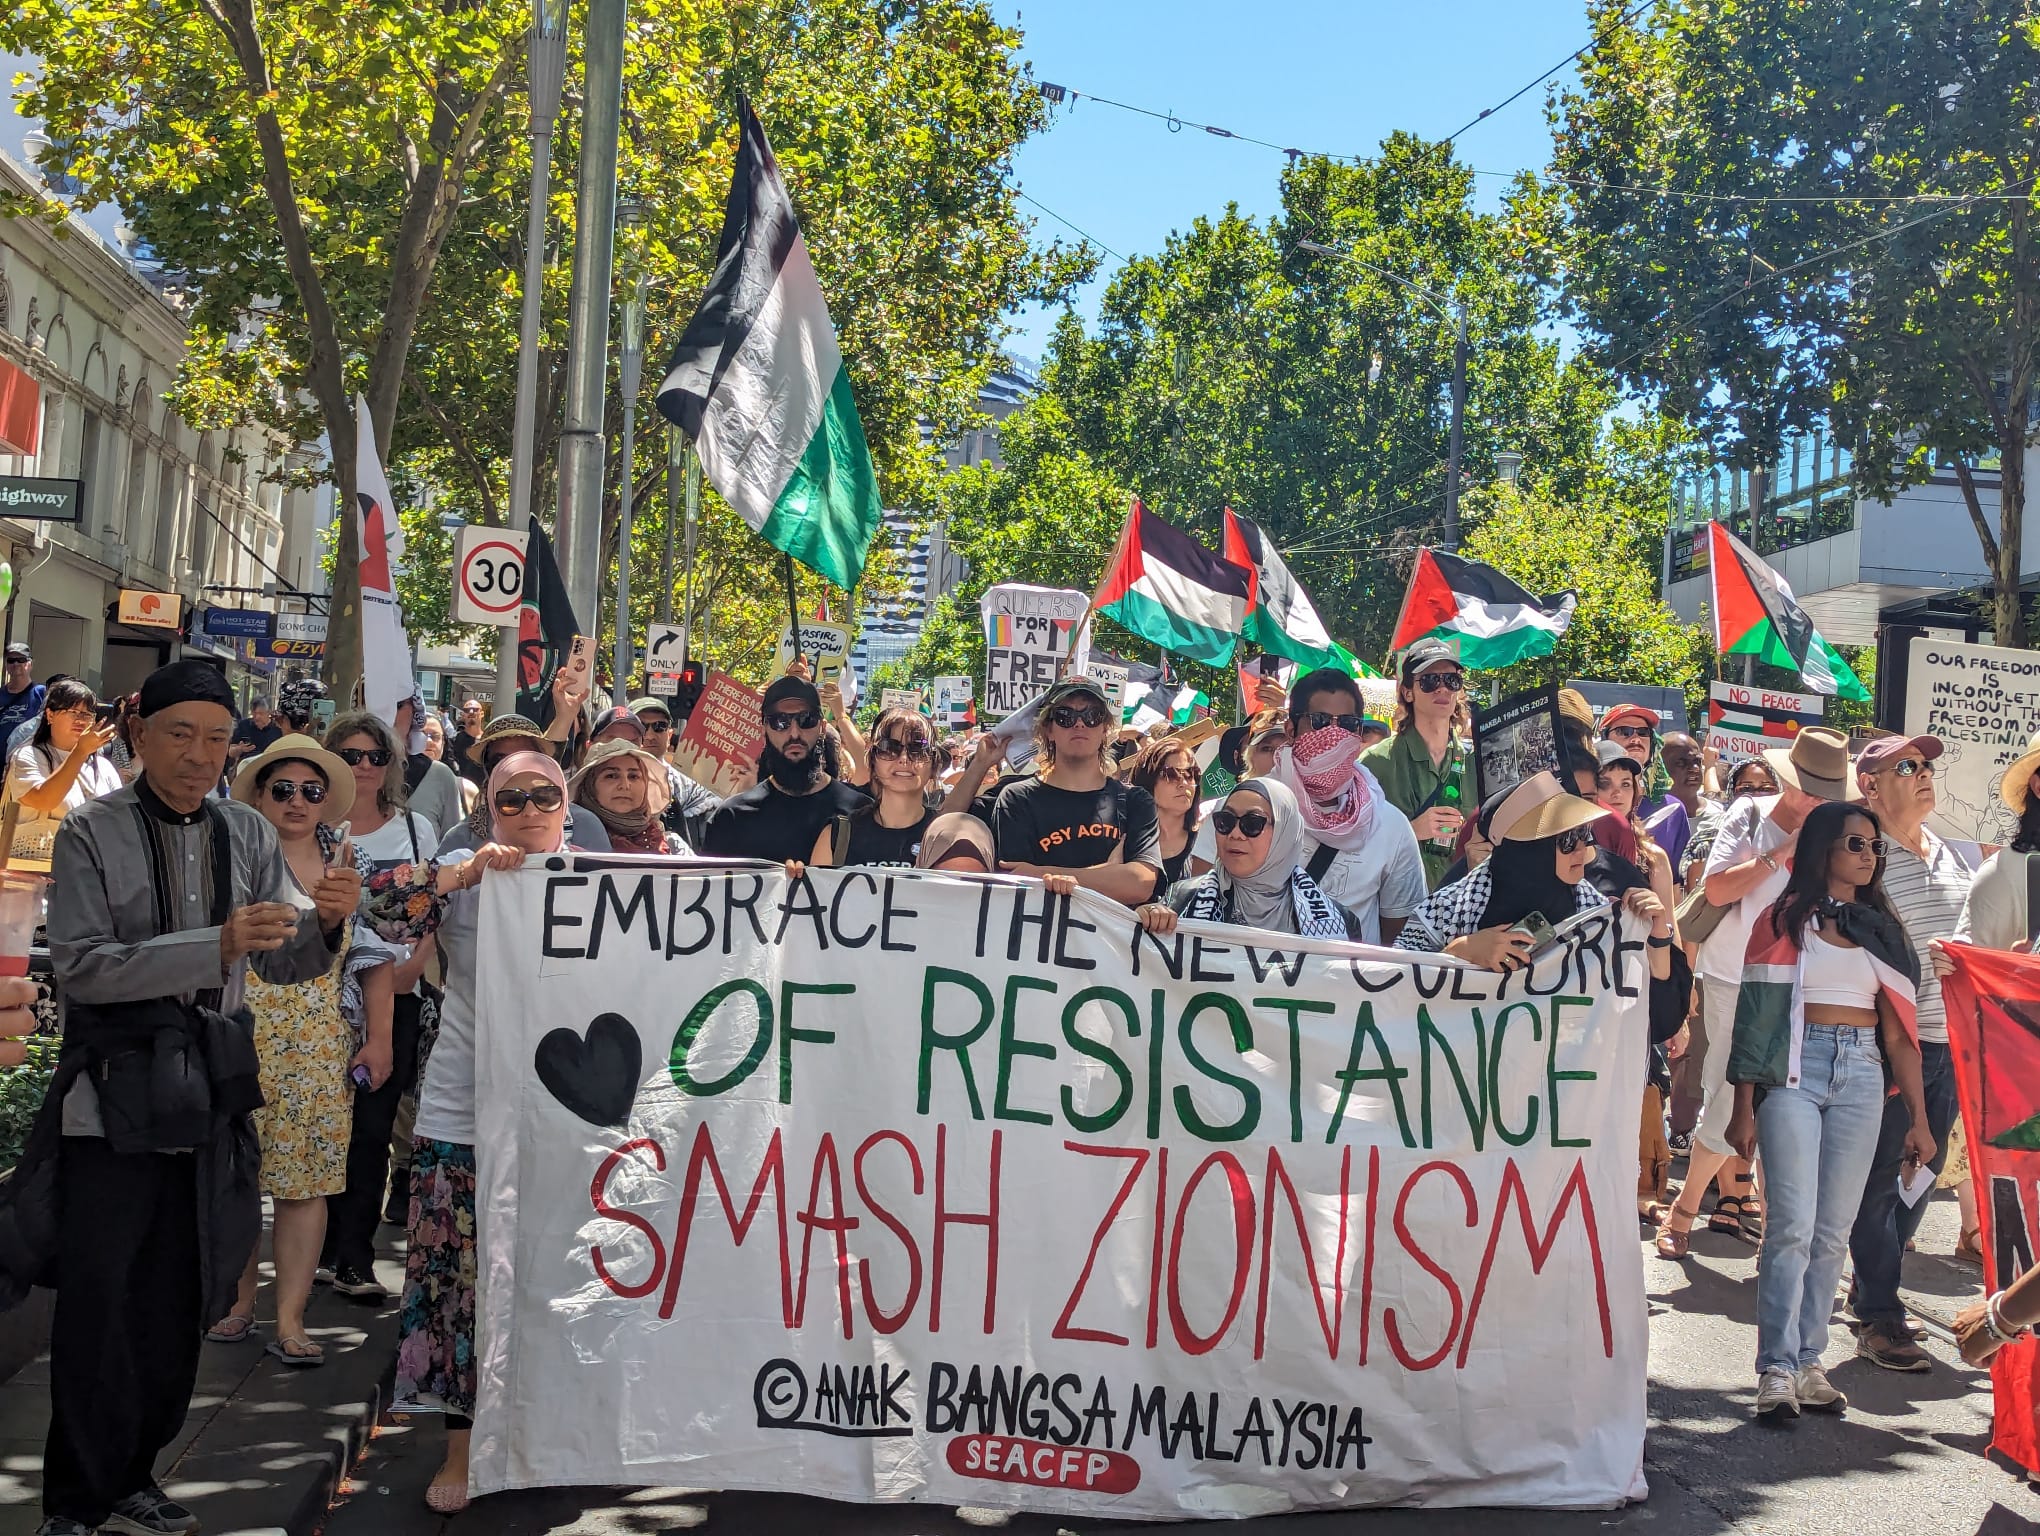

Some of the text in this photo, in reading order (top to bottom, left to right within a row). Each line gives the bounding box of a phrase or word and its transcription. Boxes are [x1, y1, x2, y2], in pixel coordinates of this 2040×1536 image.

[0, 487, 68, 508] ighway
[472, 558, 520, 596] 30
[994, 591, 1077, 617] QUEERS
[279, 622, 305, 632] GONG
[308, 623, 326, 634] CHA
[1016, 617, 1048, 631] FOR
[1024, 632, 1037, 645] A
[650, 659, 678, 669] ONLY
[1088, 665, 1110, 680] EWS
[1926, 652, 1966, 669] OUR
[714, 679, 743, 701] THERE
[741, 694, 752, 706] IS
[1983, 673, 2000, 688] IS
[707, 690, 741, 714] SPILLED
[1729, 687, 1802, 711] NO PEACE
[1932, 681, 2040, 706] INCOMPLET
[1480, 696, 1549, 732] NAKBA 1948 VS 2023
[1932, 697, 2040, 719] WITHOUT TH
[702, 702, 761, 741] IN GAZA THAN
[703, 717, 750, 749] DRINKABLE
[1929, 710, 2020, 732] FREEDOM
[705, 731, 735, 755] WATER
[1713, 735, 1728, 749] ON
[1926, 723, 2028, 747] PALESTINIA
[1039, 823, 1120, 852] PSY ACTI
[542, 871, 918, 961] EMBRACE
[975, 882, 1097, 971] THE
[668, 965, 1598, 1152] OF RESISTANCE
[590, 1121, 1614, 1372] SMASH ZIONISM
[926, 1361, 1116, 1449] BANGSA
[1121, 1383, 1373, 1469] MALAYSIA
[964, 1438, 1111, 1487] SEACFP
